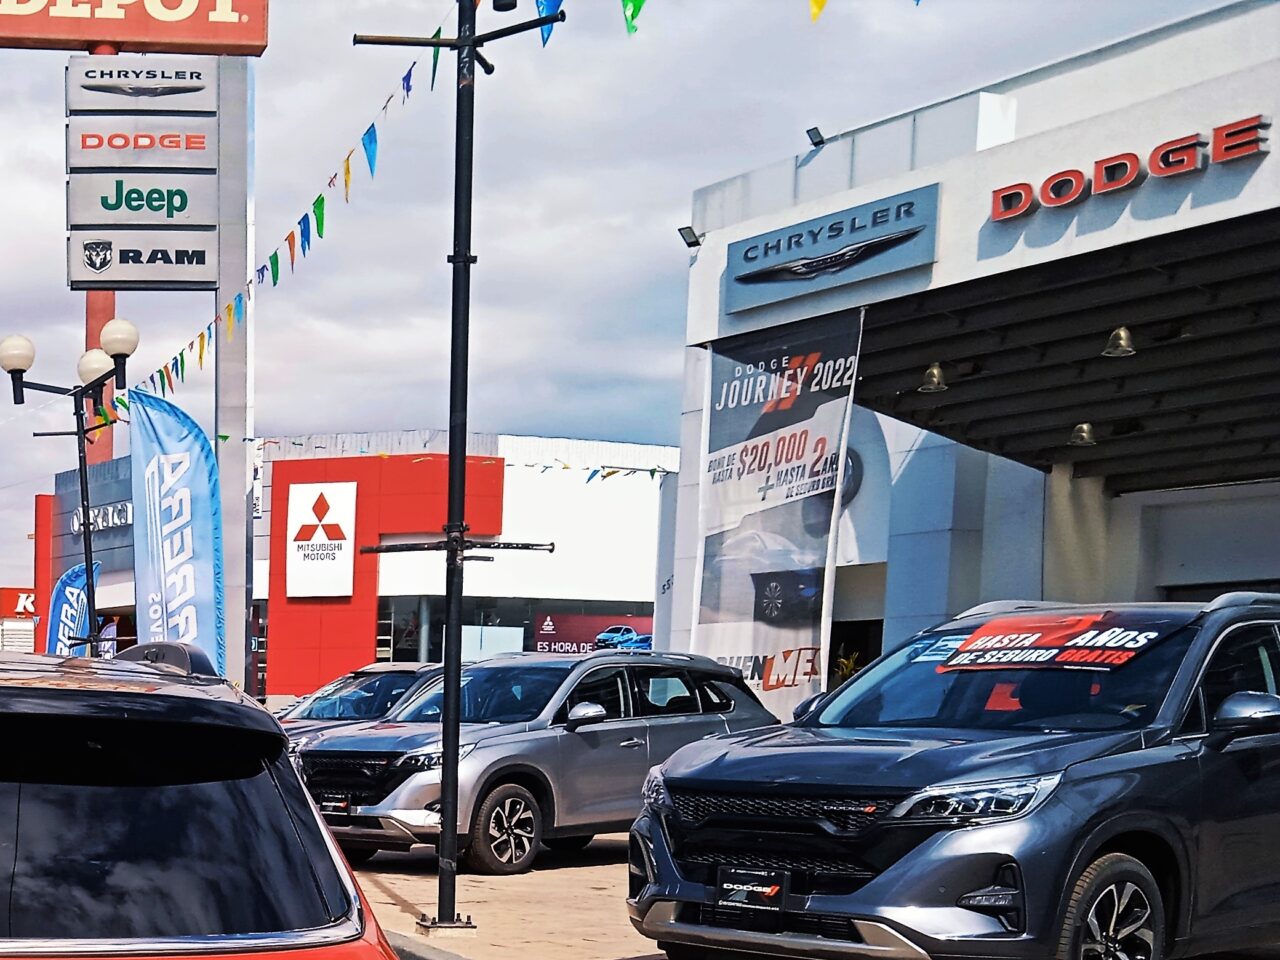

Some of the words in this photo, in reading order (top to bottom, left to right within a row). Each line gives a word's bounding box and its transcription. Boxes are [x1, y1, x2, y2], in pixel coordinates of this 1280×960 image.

[84, 70, 202, 81] CHRYSLER
[81, 133, 206, 150] DODGE
[991, 115, 1266, 222] DODGE
[100, 180, 189, 219] Jeep
[743, 201, 917, 264] CHRYSLER
[119, 249, 207, 265] RAM
[735, 356, 790, 376] DODGE
[715, 366, 808, 411] JOURNEY
[810, 355, 856, 392] 2022
[737, 429, 809, 480] $20,000
[775, 463, 807, 488] HASTA
[808, 436, 827, 479] 2
[71, 502, 133, 535] Oxaca
[297, 543, 343, 552] MITSUBISHI
[303, 552, 336, 561] MOTORS
[537, 641, 549, 652] ES
[551, 642, 578, 653] HORA
[580, 643, 593, 653] DE
[967, 633, 1043, 650] HASTA
[1064, 628, 1160, 648] AÑOS
[947, 652, 980, 666] DE
[981, 649, 1060, 664] SEGURO
[1054, 650, 1136, 664] GRATIS
[723, 883, 772, 893] DODGE
